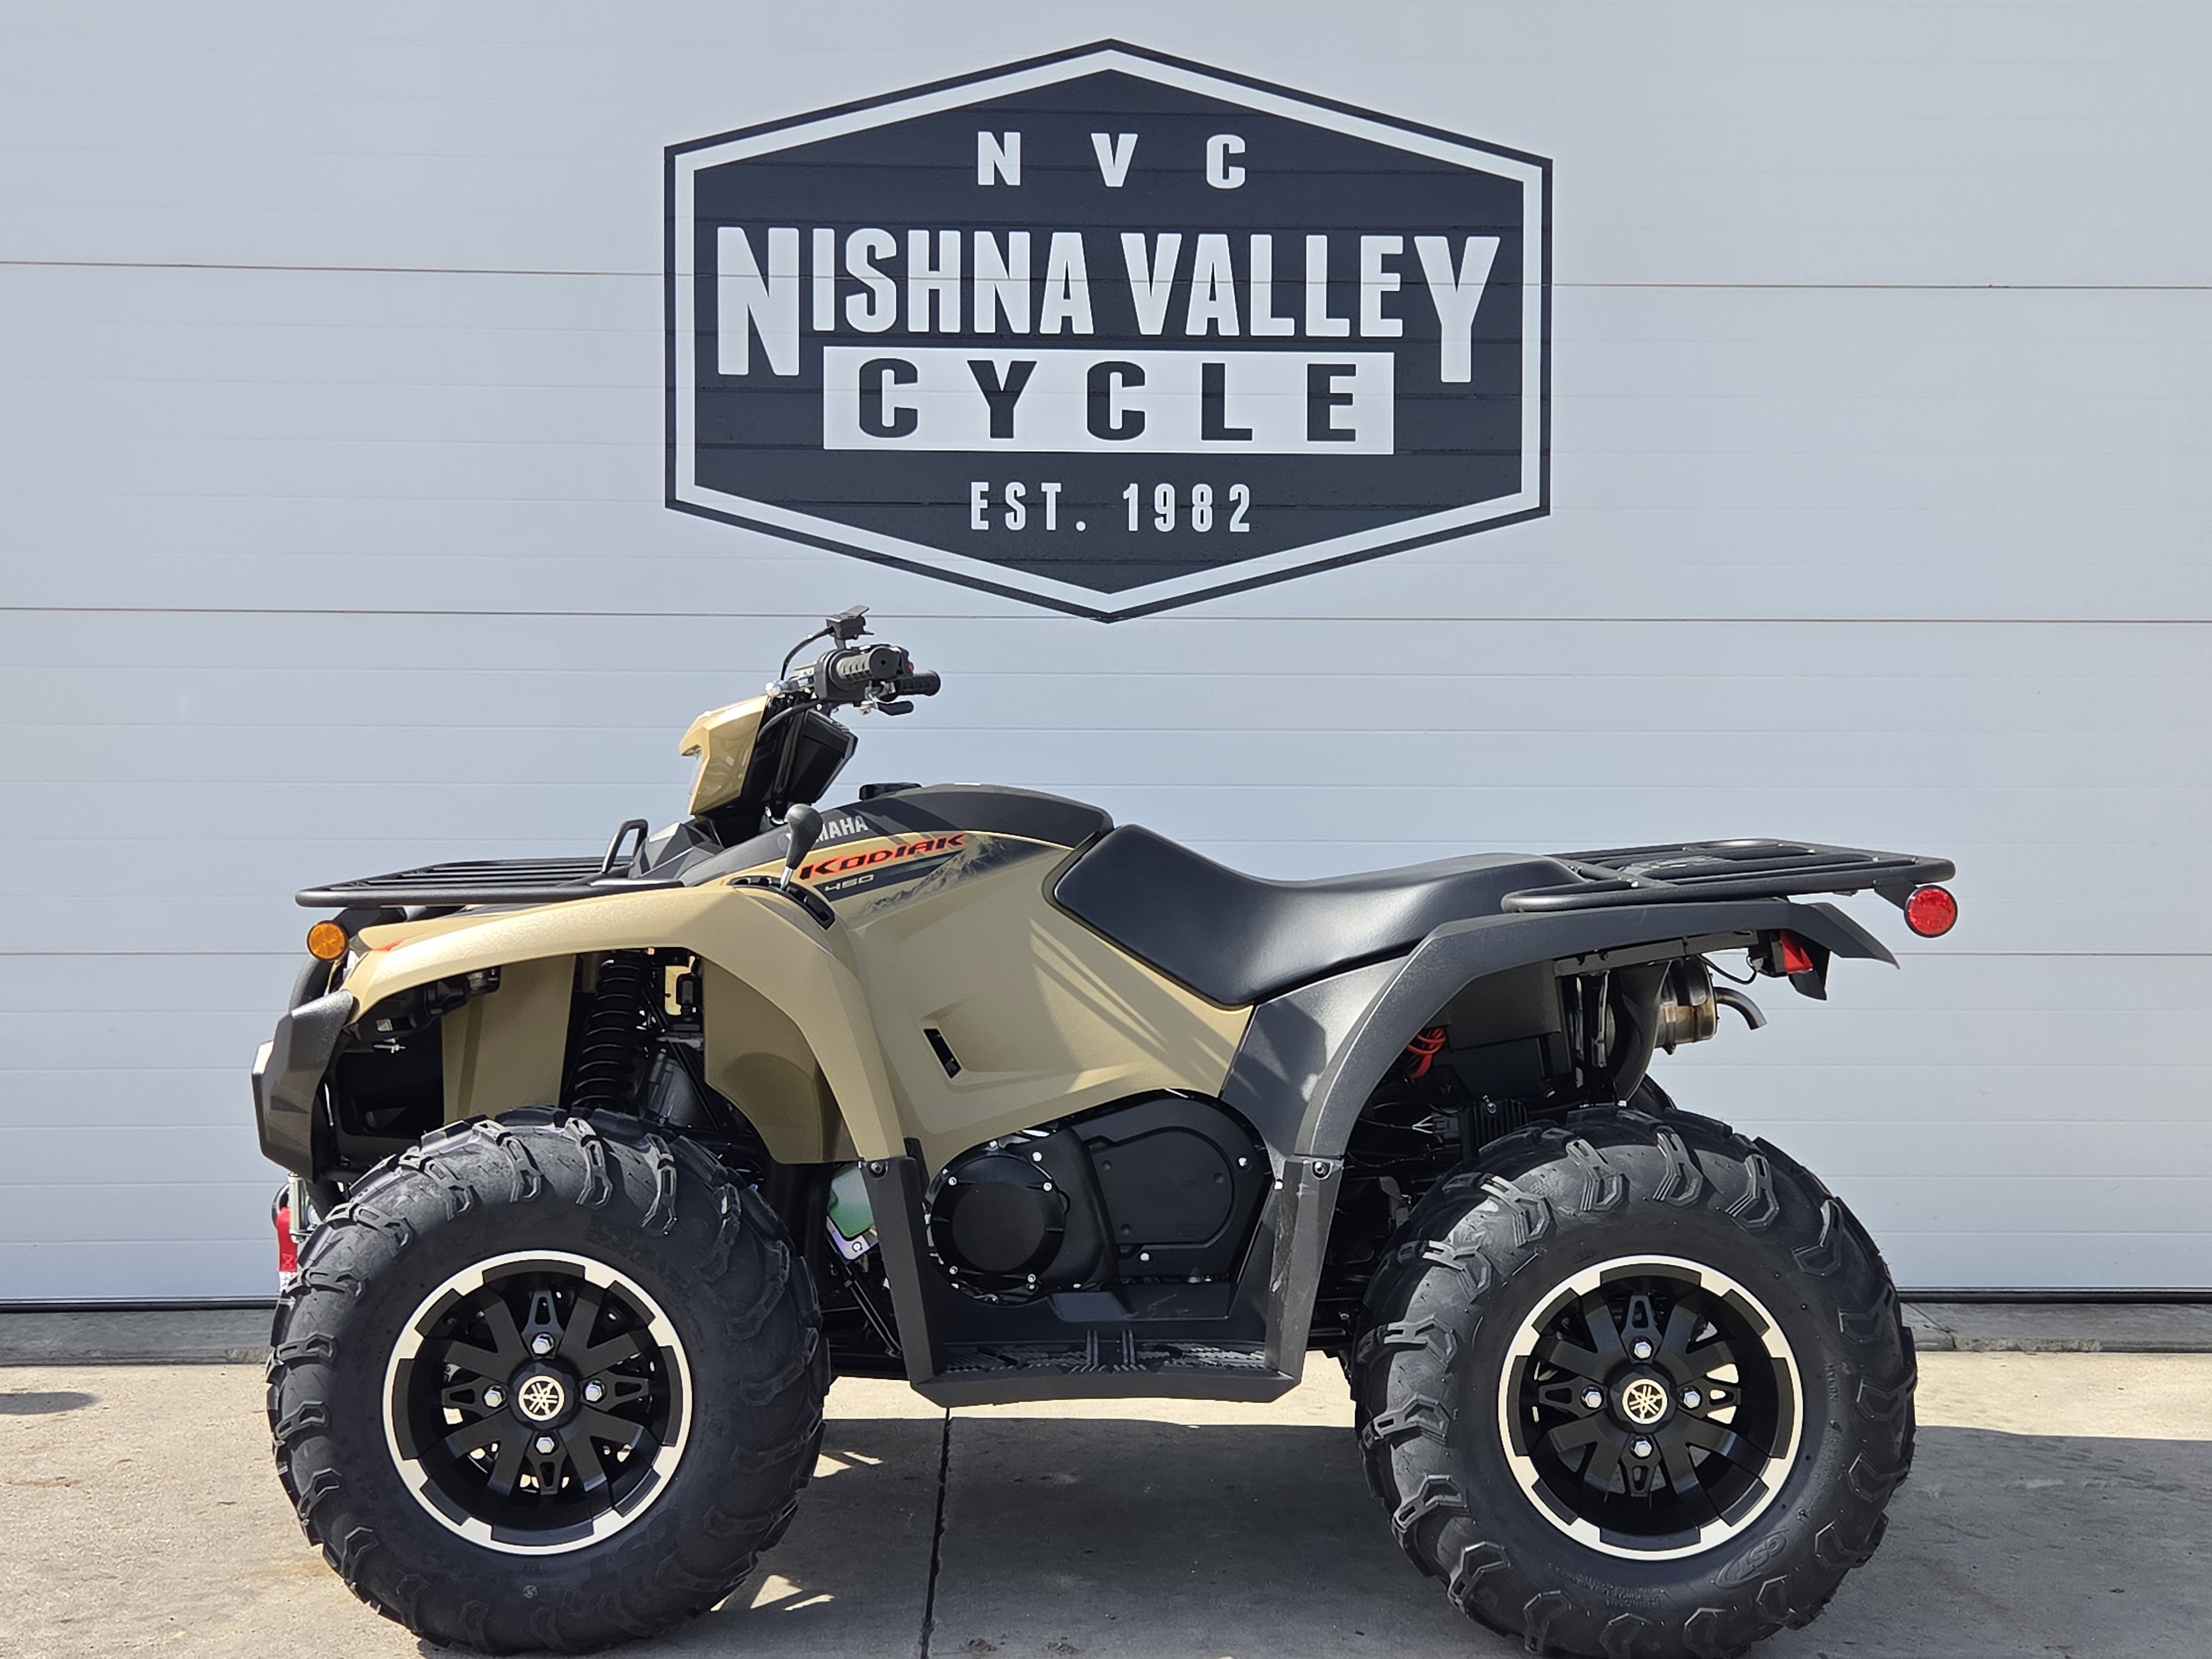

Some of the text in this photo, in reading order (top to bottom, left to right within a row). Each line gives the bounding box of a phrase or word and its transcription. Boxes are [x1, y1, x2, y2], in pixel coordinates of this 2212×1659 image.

[717, 226, 1500, 383] NISHNA VALLEY
[859, 358, 1357, 442] CYCLE
[971, 482, 1250, 533] EST. 1982
[799, 833, 966, 880] KODIAK
[825, 874, 874, 891] 450
